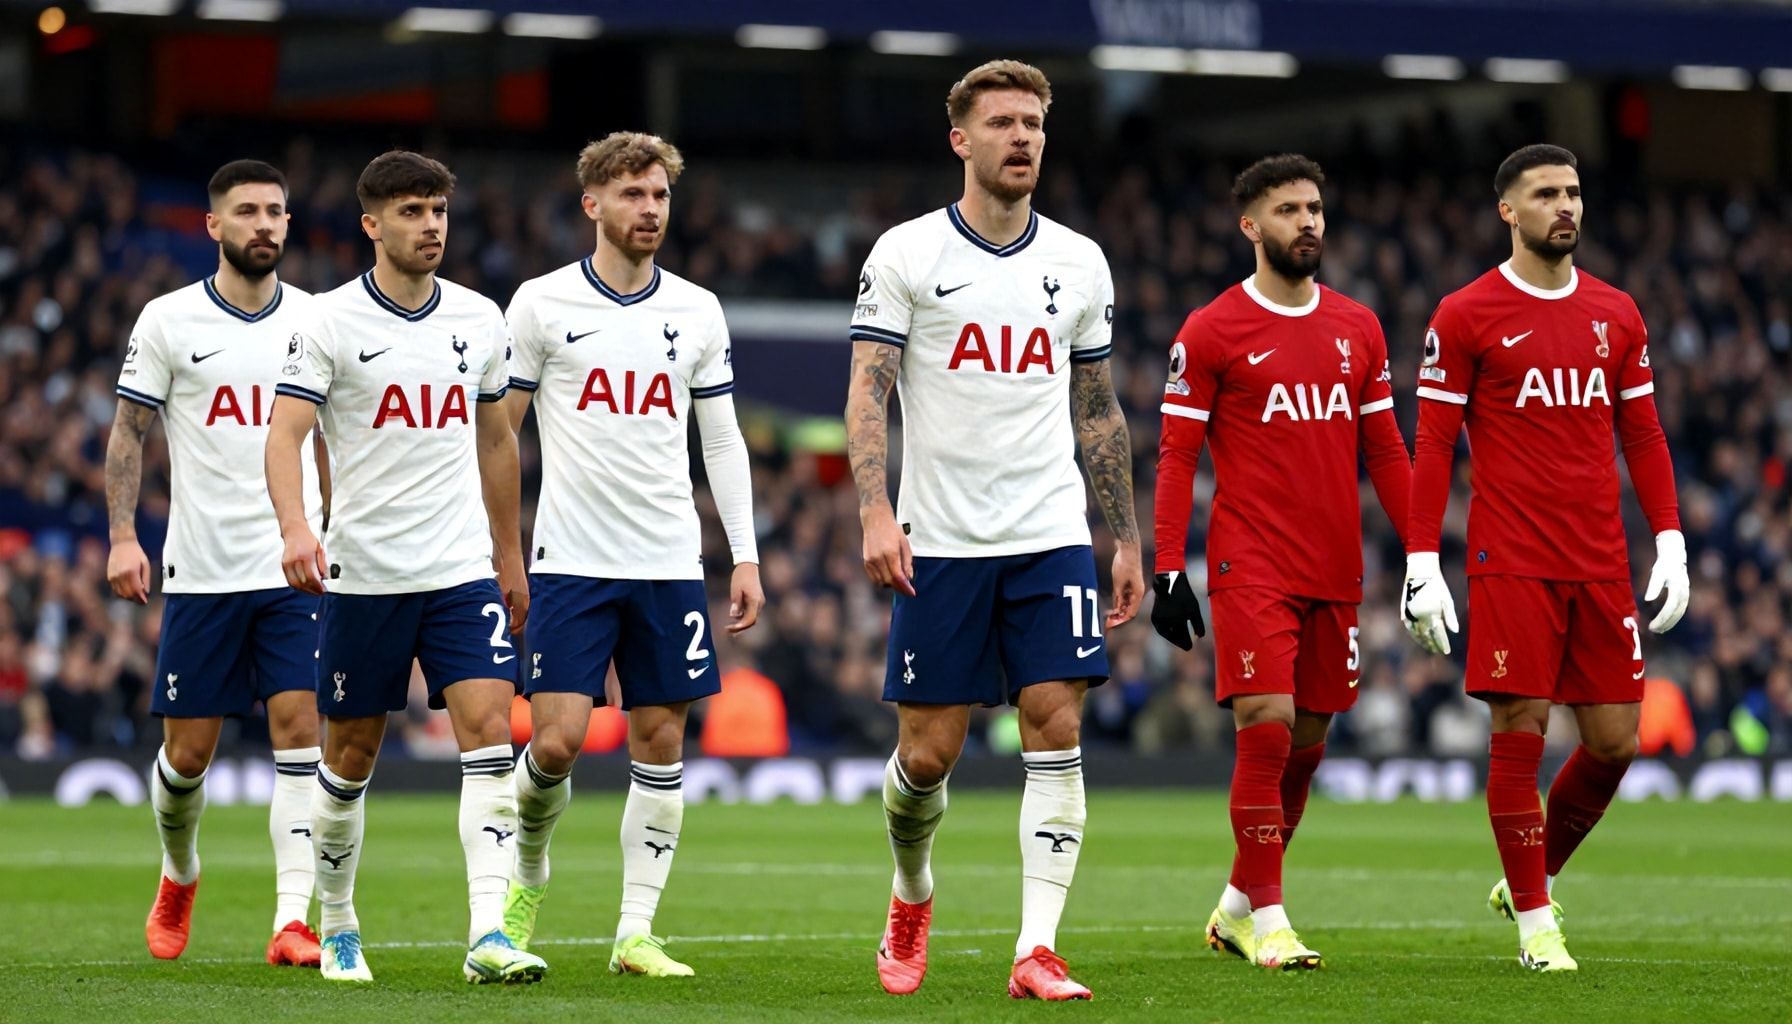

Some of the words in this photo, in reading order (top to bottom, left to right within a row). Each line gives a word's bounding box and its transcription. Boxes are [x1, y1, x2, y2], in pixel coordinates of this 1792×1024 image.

[948, 322, 1054, 375] AIA
[206, 384, 275, 427] AI
[372, 383, 469, 430] AIA
[577, 367, 679, 419] AIA
[1261, 383, 1353, 423] AIIA
[1515, 367, 1611, 408] AIIA
[481, 602, 513, 649] 2
[683, 610, 711, 661] 2
[1062, 585, 1107, 639] 11
